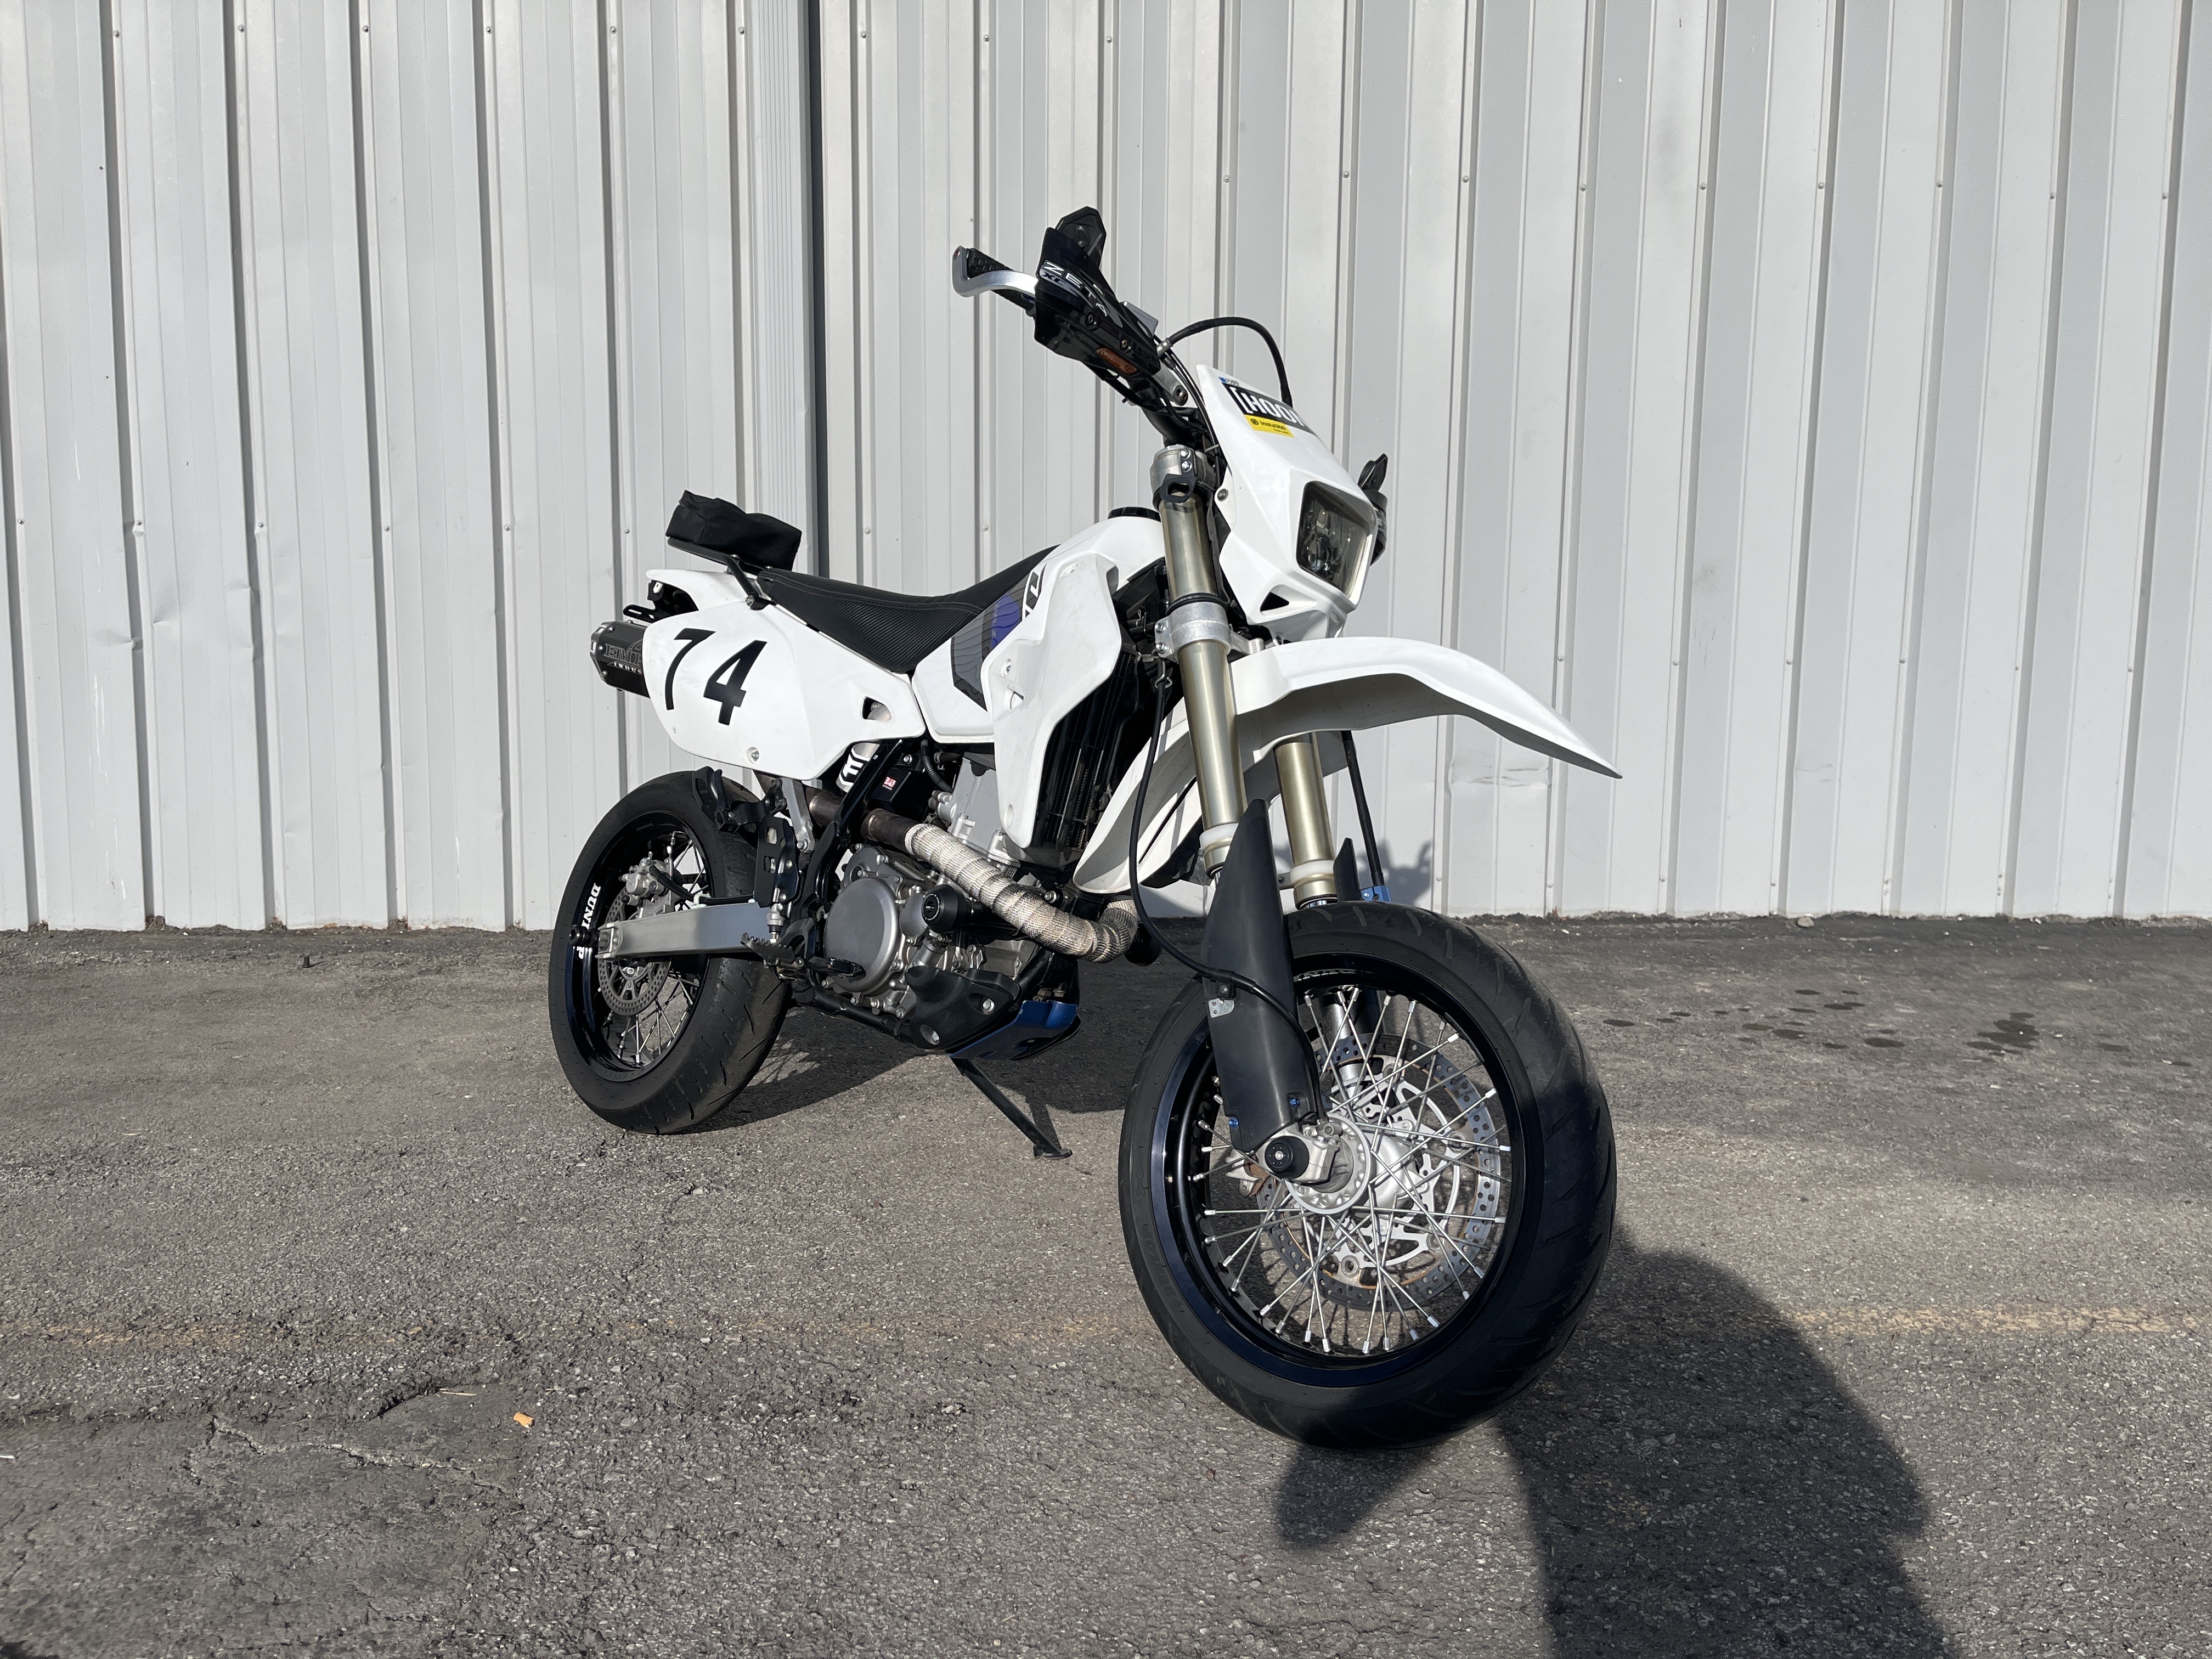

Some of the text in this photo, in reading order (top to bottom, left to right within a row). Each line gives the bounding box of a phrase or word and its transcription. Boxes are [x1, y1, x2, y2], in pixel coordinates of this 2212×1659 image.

[1043, 260, 1108, 318] ZETA
[665, 628, 768, 726] 74
[577, 883, 601, 960] DUNLP
